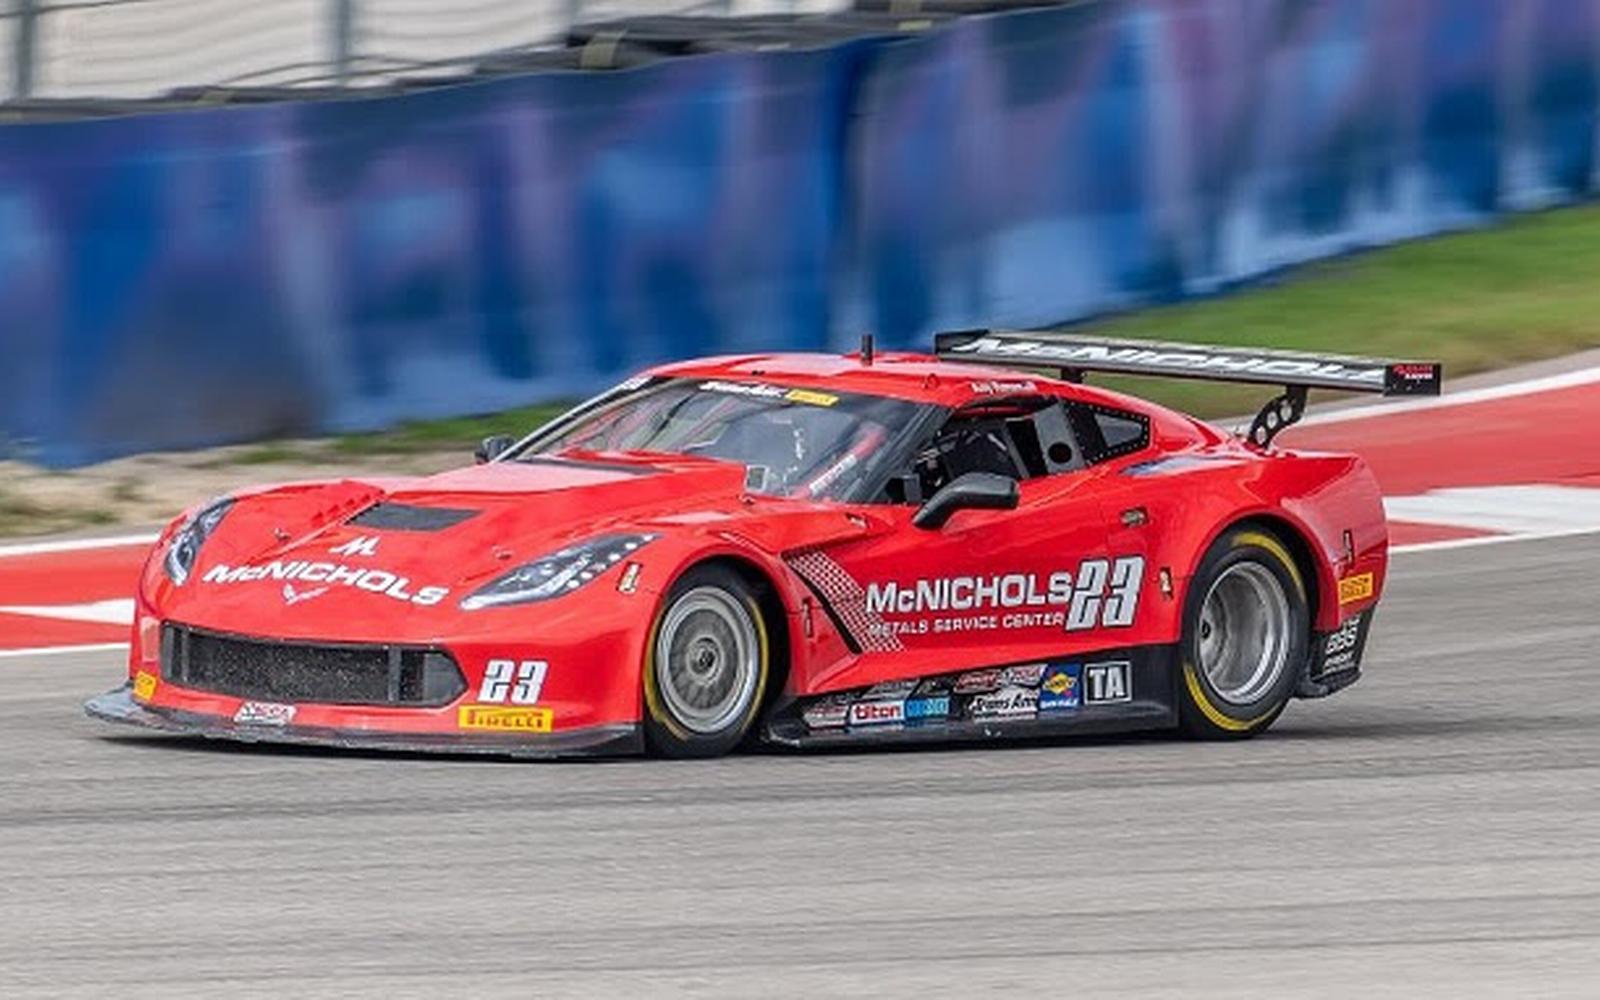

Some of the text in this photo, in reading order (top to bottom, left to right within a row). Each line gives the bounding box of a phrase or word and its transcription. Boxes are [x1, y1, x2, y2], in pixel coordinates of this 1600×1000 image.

[201, 560, 450, 606] McNICHOLS
[866, 570, 1073, 613] McNICHOLS
[1065, 555, 1146, 631] 23
[869, 612, 1065, 637] METALS SERVICE CENTER
[477, 659, 549, 704] 23
[1088, 665, 1127, 699] TA
[465, 708, 543, 727] PIRELLI
